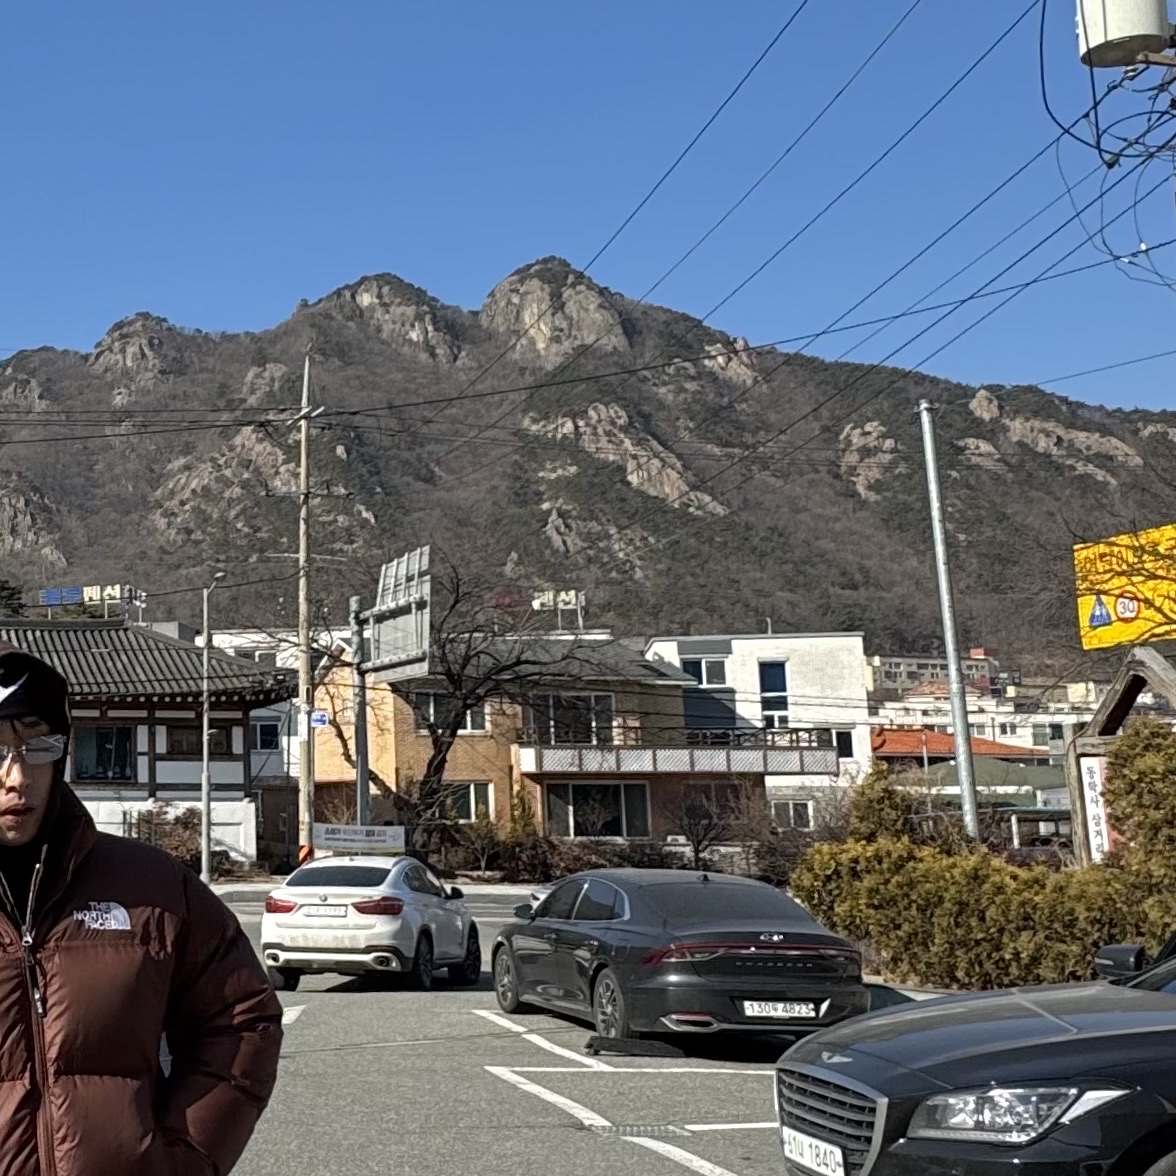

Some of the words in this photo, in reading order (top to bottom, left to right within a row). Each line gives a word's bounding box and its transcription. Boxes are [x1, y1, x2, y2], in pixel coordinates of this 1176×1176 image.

[1118, 600, 1137, 616] 30
[1085, 765, 1100, 808] 동학사
[87, 901, 111, 912] THE
[73, 910, 111, 921] NORTH
[85, 919, 113, 930] FACE
[781, 1002, 812, 1016] 4823
[808, 1141, 838, 1174] 1840
